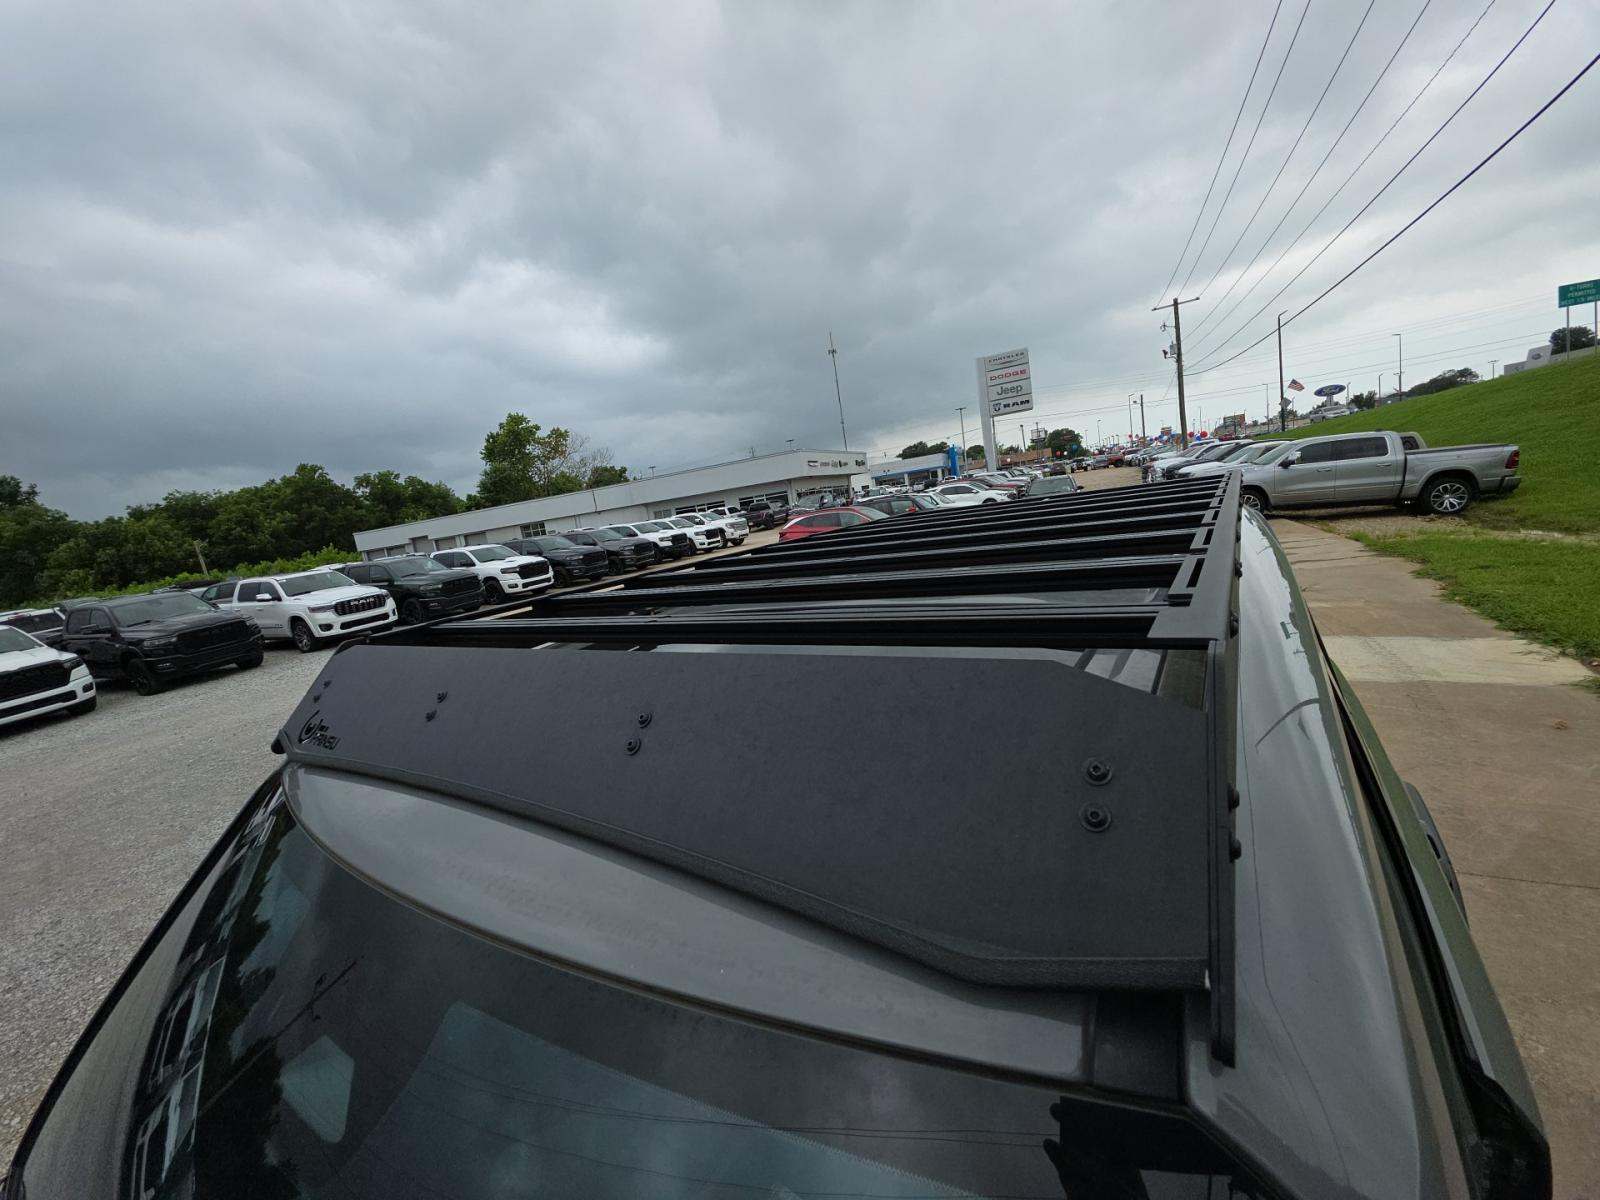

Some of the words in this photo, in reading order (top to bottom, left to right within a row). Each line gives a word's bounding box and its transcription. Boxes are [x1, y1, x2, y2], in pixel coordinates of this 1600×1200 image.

[990, 369, 1027, 381] DODGE
[996, 384, 1023, 396] Jeep
[1003, 399, 1030, 408] RAM
